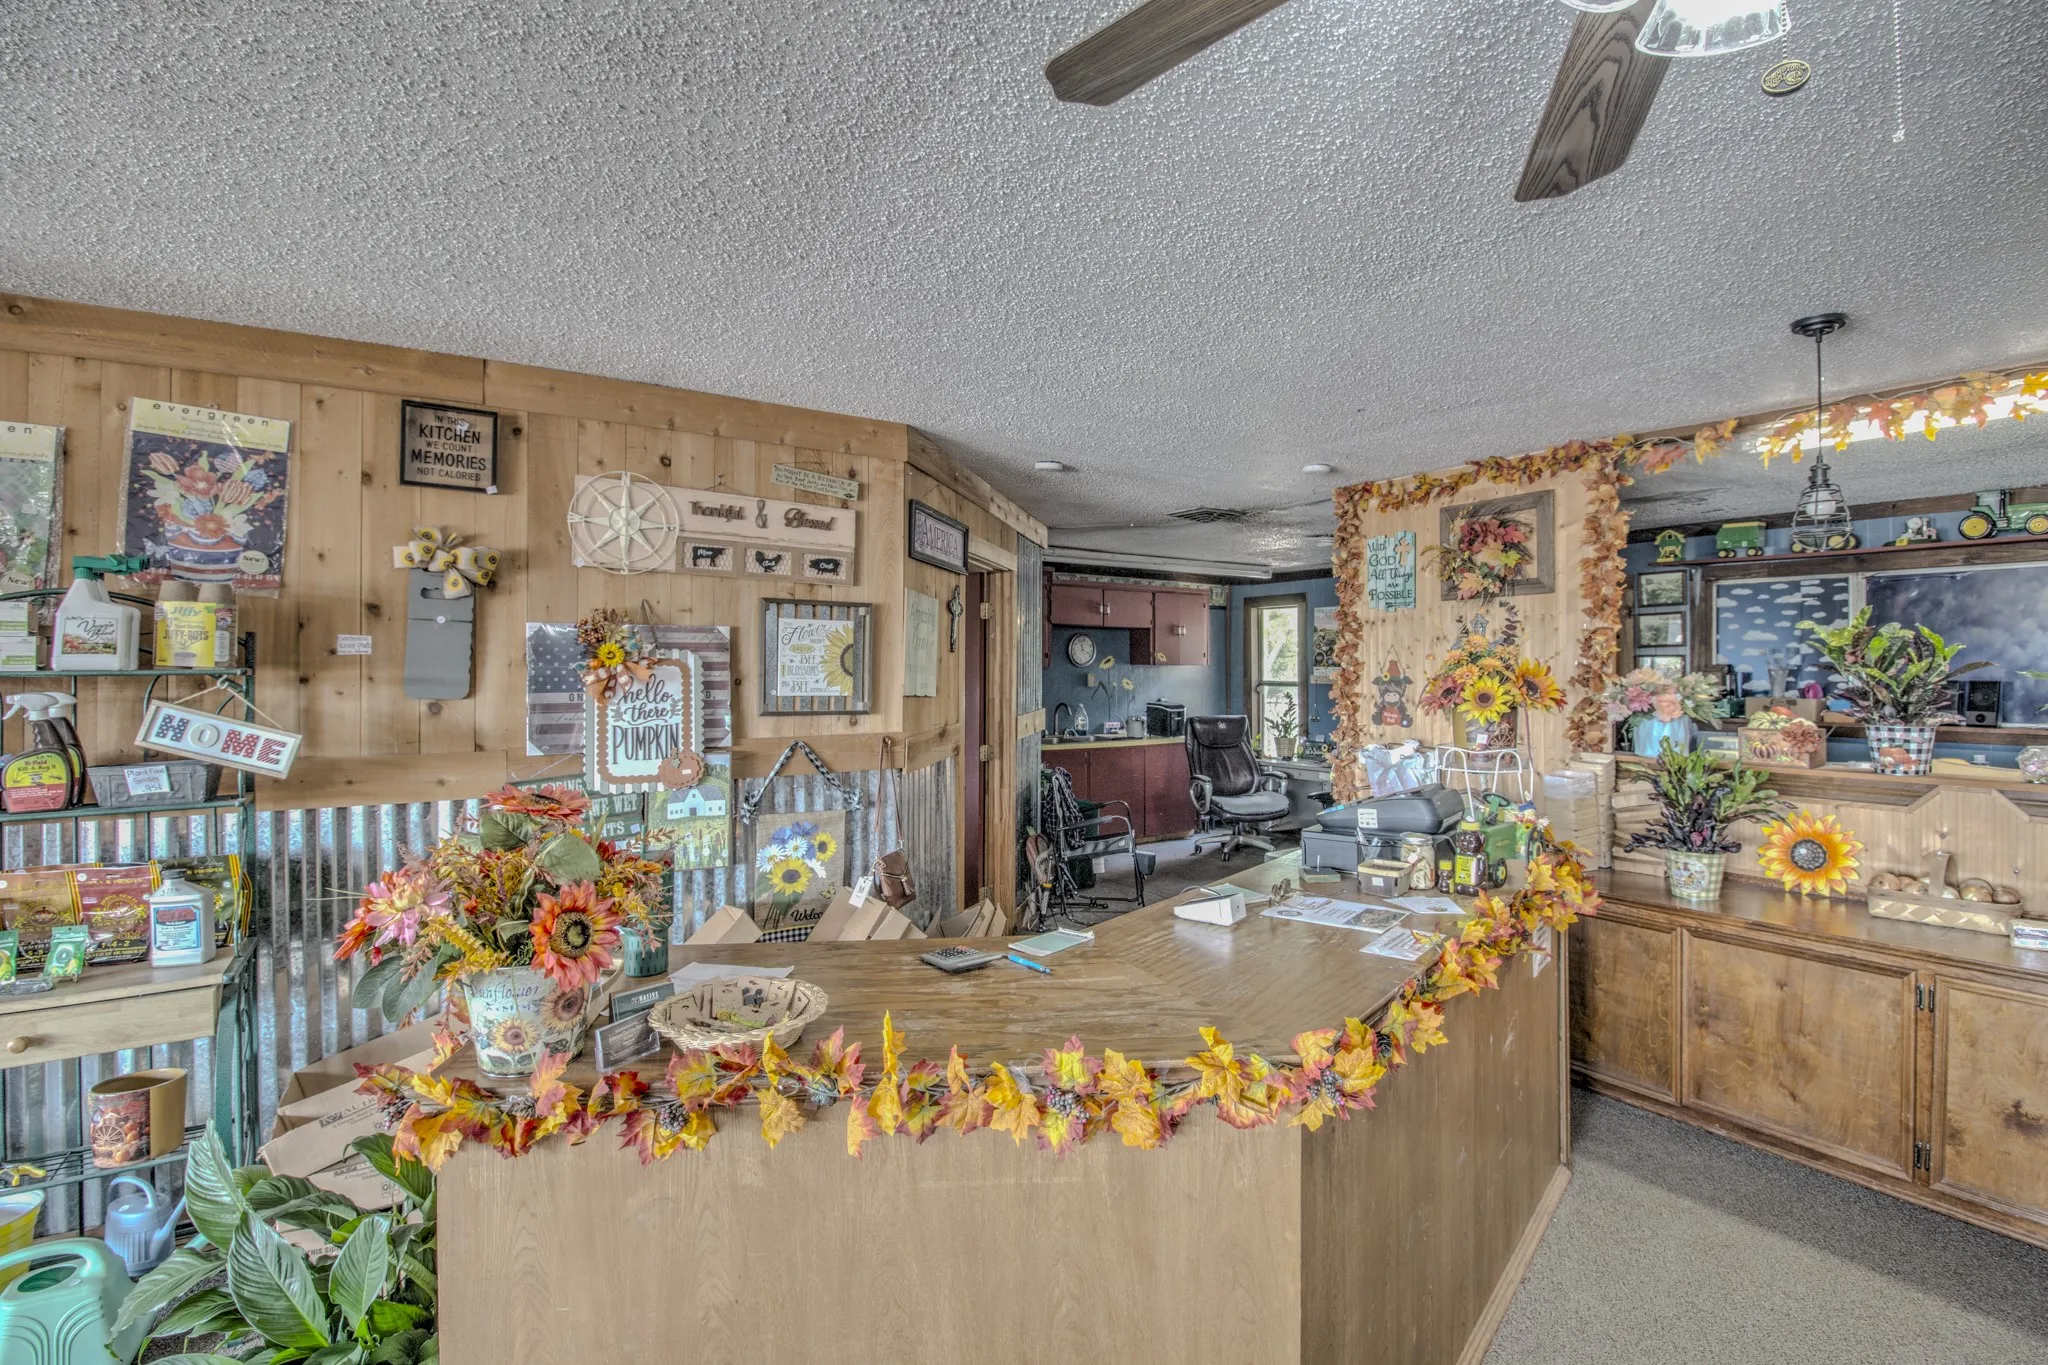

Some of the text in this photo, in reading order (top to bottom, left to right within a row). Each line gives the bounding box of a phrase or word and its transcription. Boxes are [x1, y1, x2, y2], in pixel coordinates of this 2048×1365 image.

[153, 402, 269, 428] evergreen
[434, 415, 465, 427] IN THIS
[419, 422, 481, 444] KITCHEN
[426, 440, 472, 453] WE COUNT
[410, 448, 487, 471] MEMORIES
[417, 466, 481, 482] NOT CALORIES
[621, 471, 631, 486] N
[688, 499, 836, 531] Thankful & Blessed
[920, 515, 959, 555] AMERICA
[621, 561, 629, 574] S
[1369, 554, 1396, 567] GOD
[1370, 567, 1413, 583] All Things
[1368, 589, 1413, 601] POSSIBLE
[781, 624, 832, 645] Flower
[569, 693, 584, 702] ON
[616, 673, 674, 707] hello
[624, 702, 669, 722] there
[155, 713, 287, 765] HOME
[611, 722, 681, 765] PUMPKIN
[127, 769, 148, 777] Plant
[613, 792, 638, 814] WET
[791, 908, 823, 922] Welco
